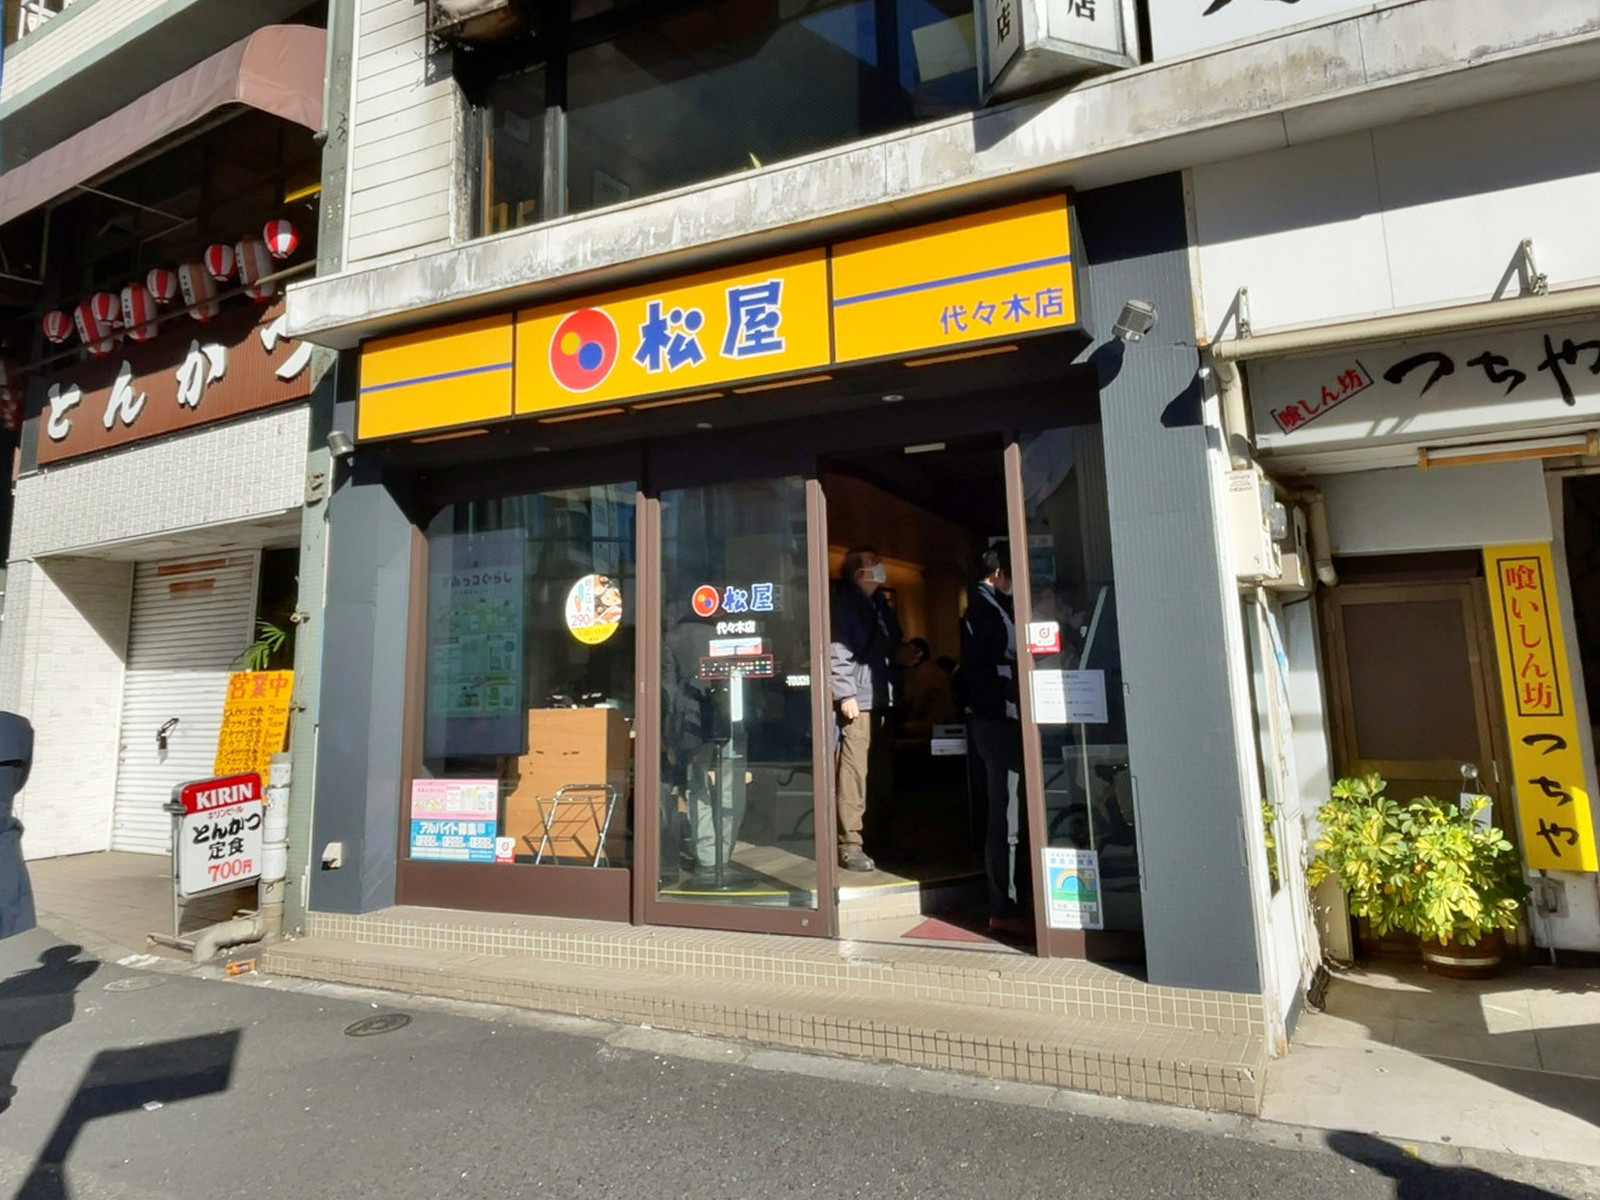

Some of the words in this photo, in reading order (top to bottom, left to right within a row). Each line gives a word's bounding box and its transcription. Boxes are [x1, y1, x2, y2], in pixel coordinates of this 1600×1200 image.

[632, 278, 785, 373] 松屋
[939, 287, 1064, 335] 代々木店
[1383, 334, 1600, 406] つちや
[721, 582, 774, 613] 松屋
[716, 620, 756, 635] 代々木店
[1504, 564, 1553, 710] 喰いしん坊
[230, 674, 288, 699] 営業中
[195, 782, 253, 810] KIRIN
[1521, 732, 1580, 858] つちや
[192, 812, 262, 844] とんかつ
[207, 806, 244, 819] キリンビール
[208, 837, 245, 861] 定食
[208, 858, 253, 882] 700円
